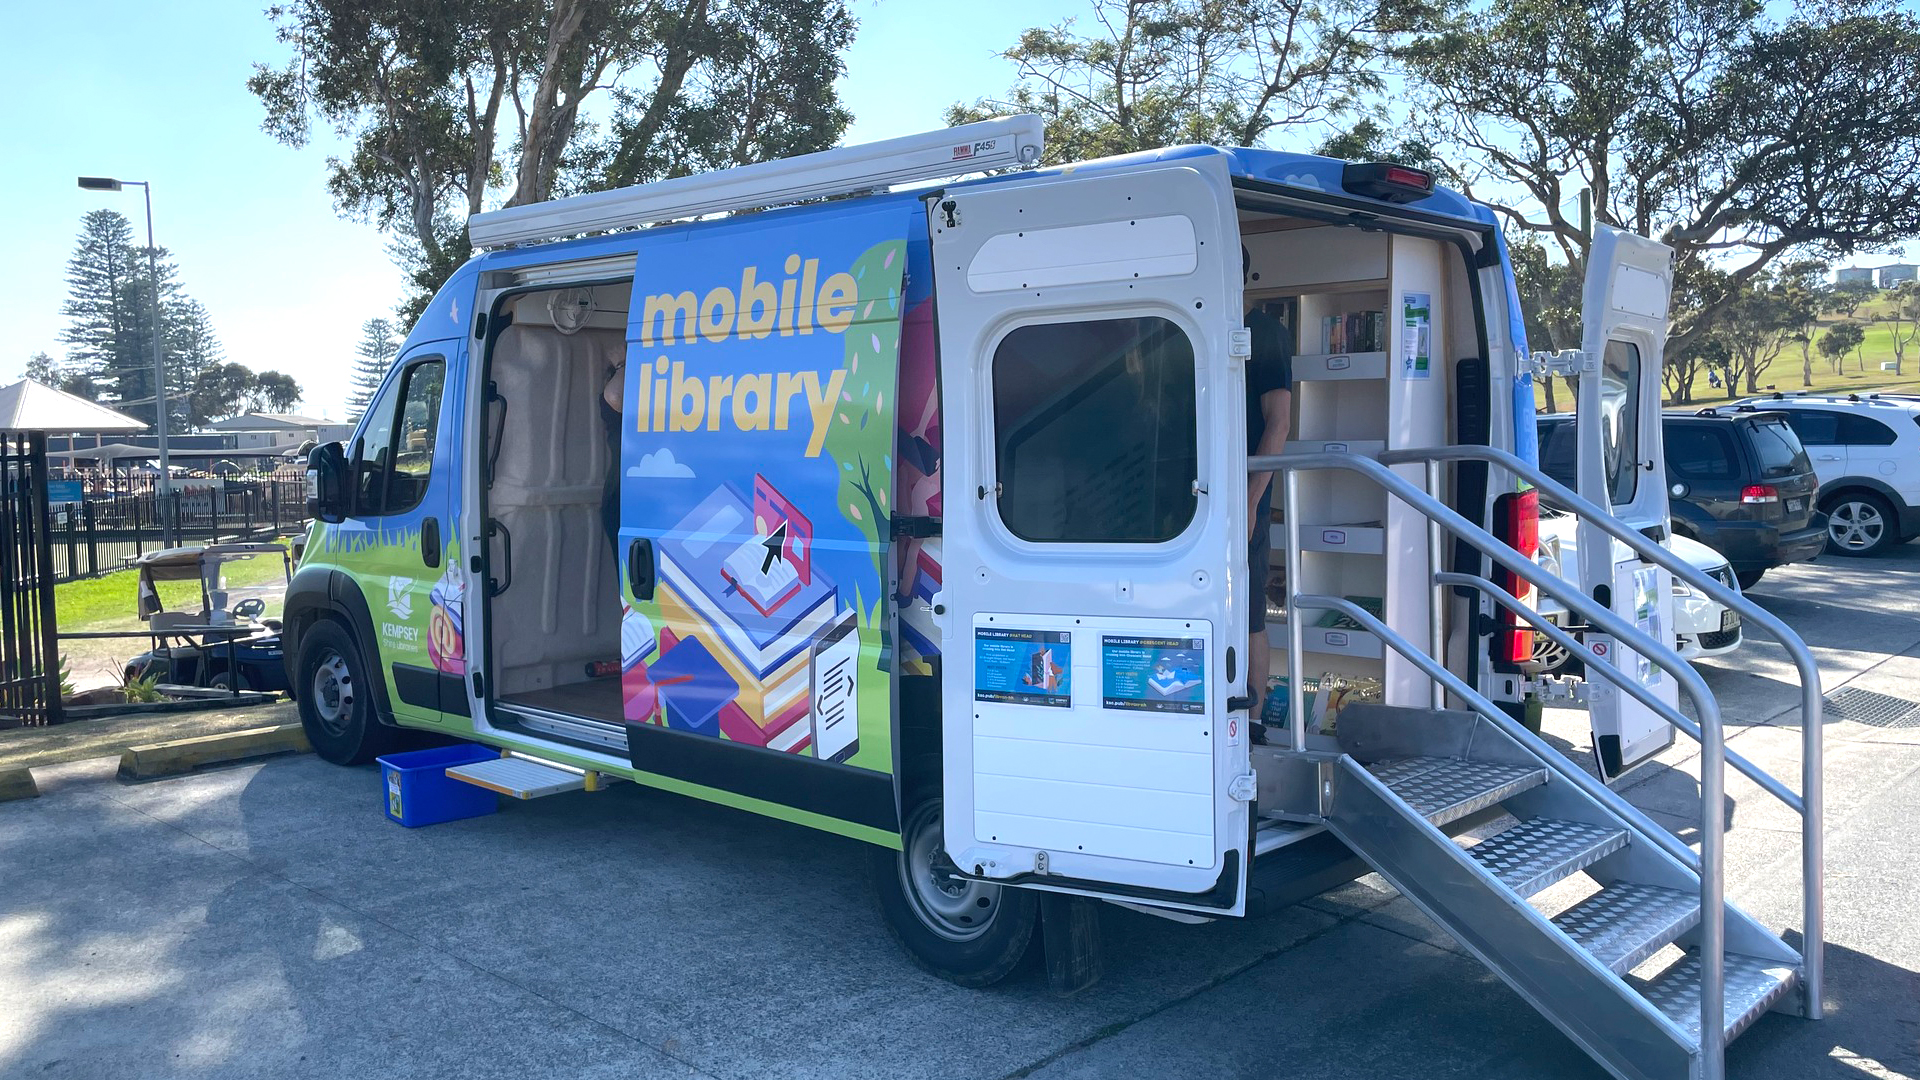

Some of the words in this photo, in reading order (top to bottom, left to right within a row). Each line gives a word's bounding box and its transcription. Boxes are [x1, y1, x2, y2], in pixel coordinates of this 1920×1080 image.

[641, 253, 859, 348] mobile
[637, 355, 848, 458] library
[382, 622, 418, 641] KEMPSEY
